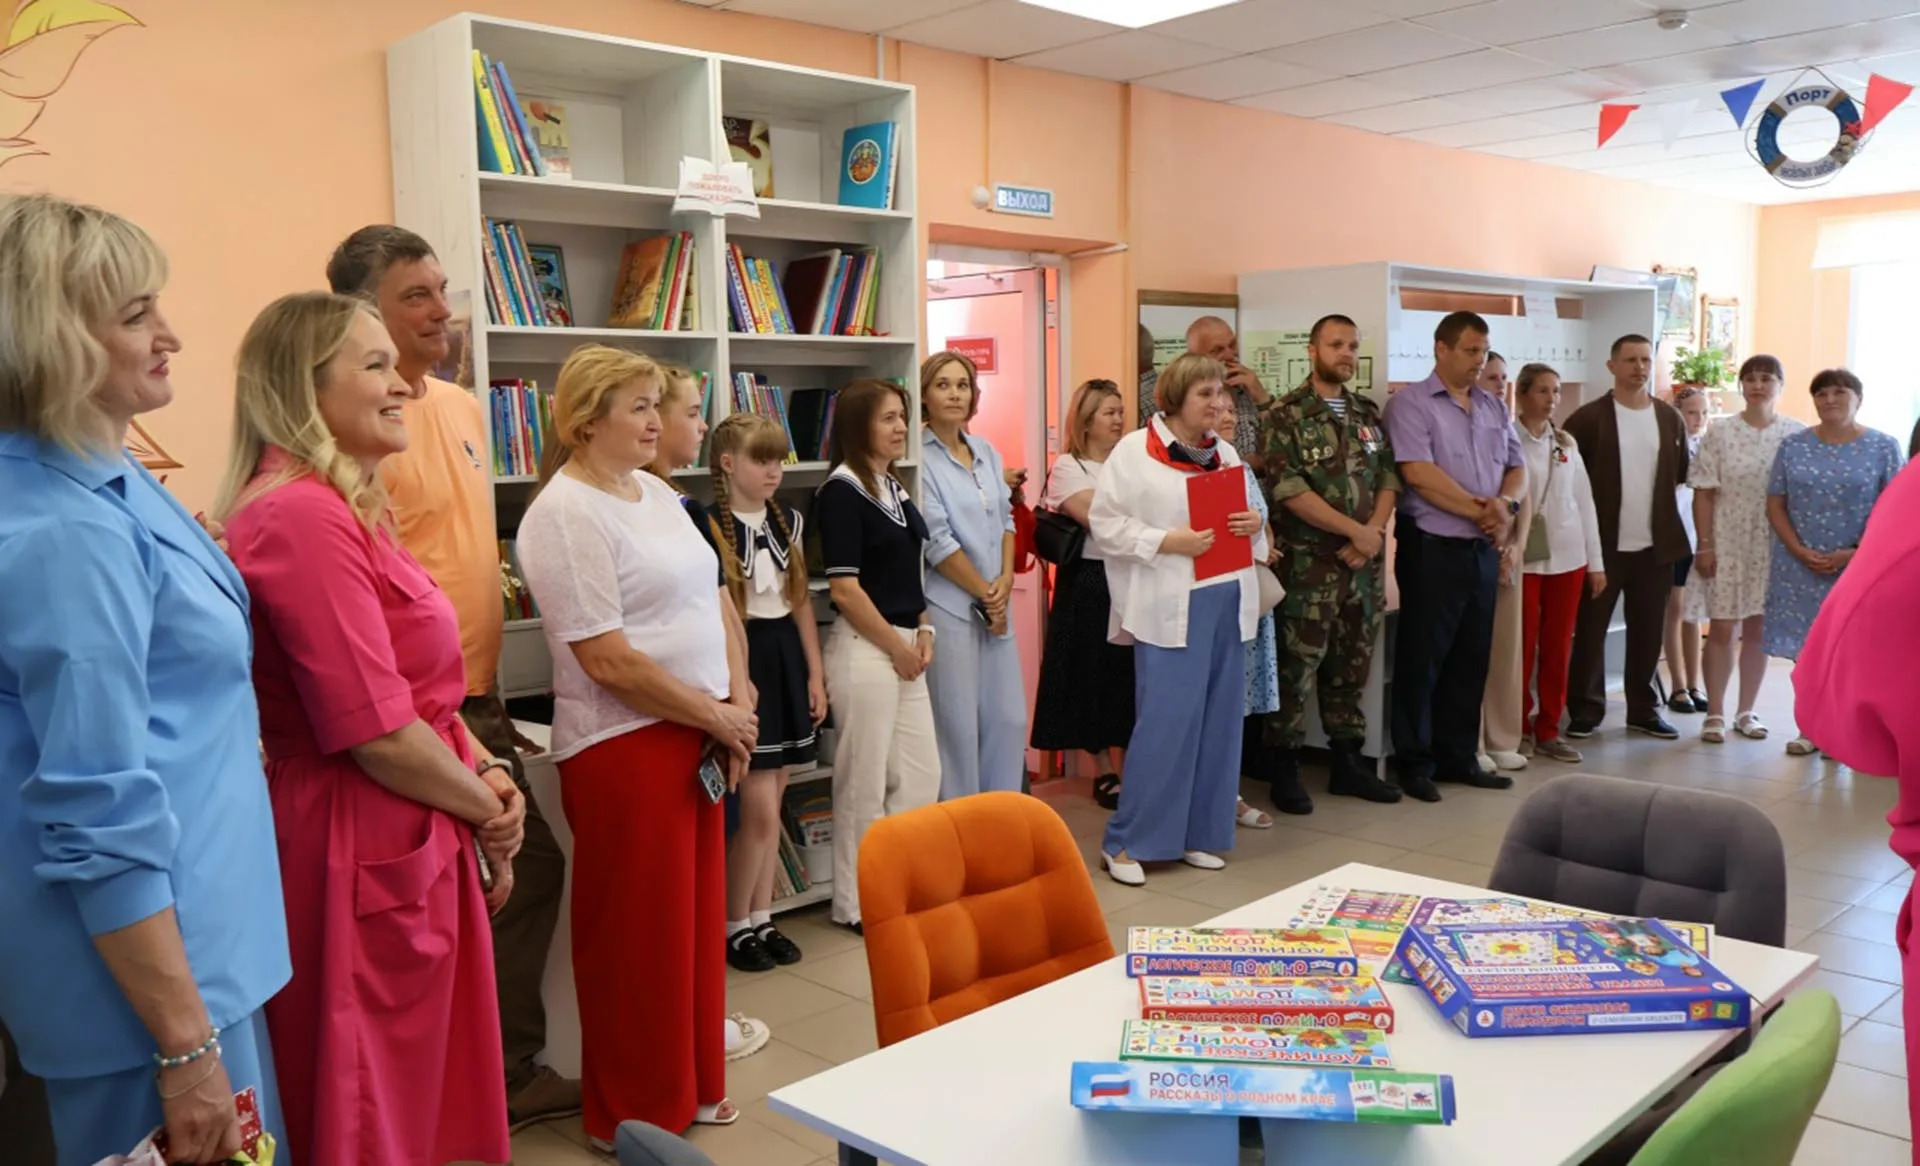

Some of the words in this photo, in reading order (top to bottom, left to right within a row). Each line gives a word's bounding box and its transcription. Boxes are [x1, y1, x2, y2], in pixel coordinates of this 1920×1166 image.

[1785, 89, 1831, 106] Порт
[998, 189, 1048, 211] ВЫХОД
[1156, 935, 1267, 946] ДОМИНО
[1198, 945, 1326, 954] ЛОГИЧЕСКОЕ
[1149, 958, 1232, 973] ЛОГИЧЕСКОЕ
[1232, 959, 1307, 977] ДОМИНО
[1172, 988, 1294, 1001] ДОМИНО
[1167, 1012, 1258, 1025] ЛОГИЧЕСКОЕ
[1261, 1013, 1340, 1028] ДОМИНО
[1156, 1034, 1290, 1049] ДОМИНО
[1203, 1046, 1362, 1064] ЛОГИЧЕСКОЕ
[1150, 1072, 1229, 1088] РОССИЯ
[1150, 1089, 1223, 1102] РАССКАЗЫ
[1225, 1092, 1235, 1103] О
[1239, 1091, 1297, 1104] РОДНОМ
[1301, 1093, 1335, 1106] КРАЕ
